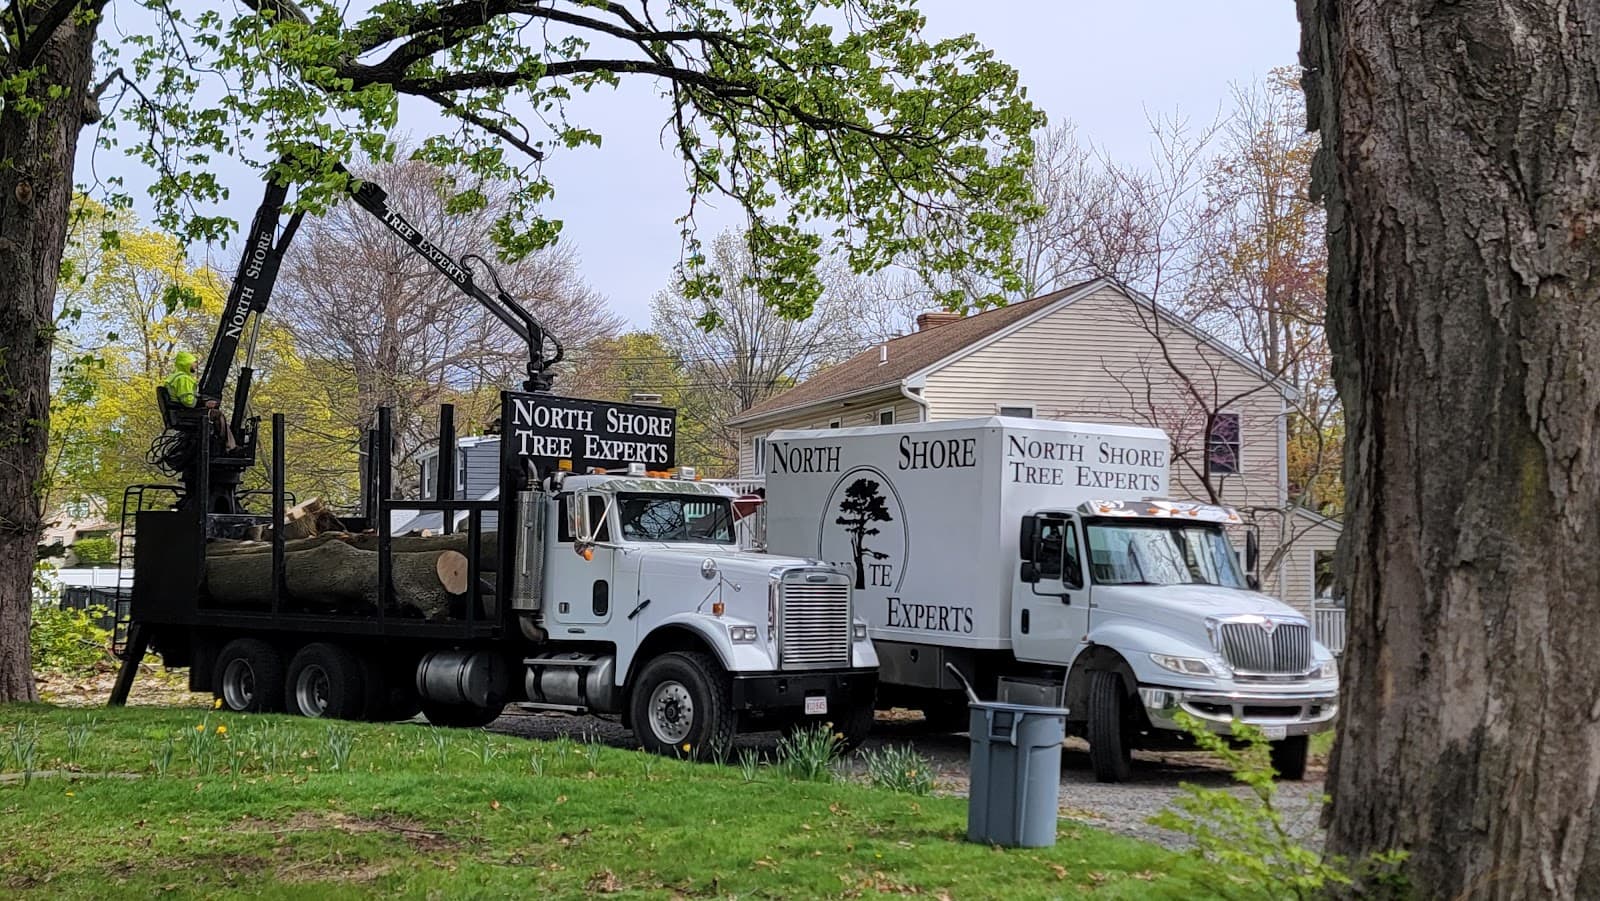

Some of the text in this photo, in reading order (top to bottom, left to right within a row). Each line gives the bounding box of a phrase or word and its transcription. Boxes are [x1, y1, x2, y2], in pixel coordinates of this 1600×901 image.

[382, 207, 468, 284] TREE EXPERTS
[225, 231, 272, 339] NORTH SHORE
[512, 399, 672, 437] NORTH SHORE
[515, 429, 668, 464] TREE EXPERTS
[771, 435, 976, 474] NORTH SHORE
[1007, 435, 1164, 468] NORTH SHORE
[1009, 462, 1160, 492] TREE EXPERTS
[887, 597, 974, 634] EXPERTS
